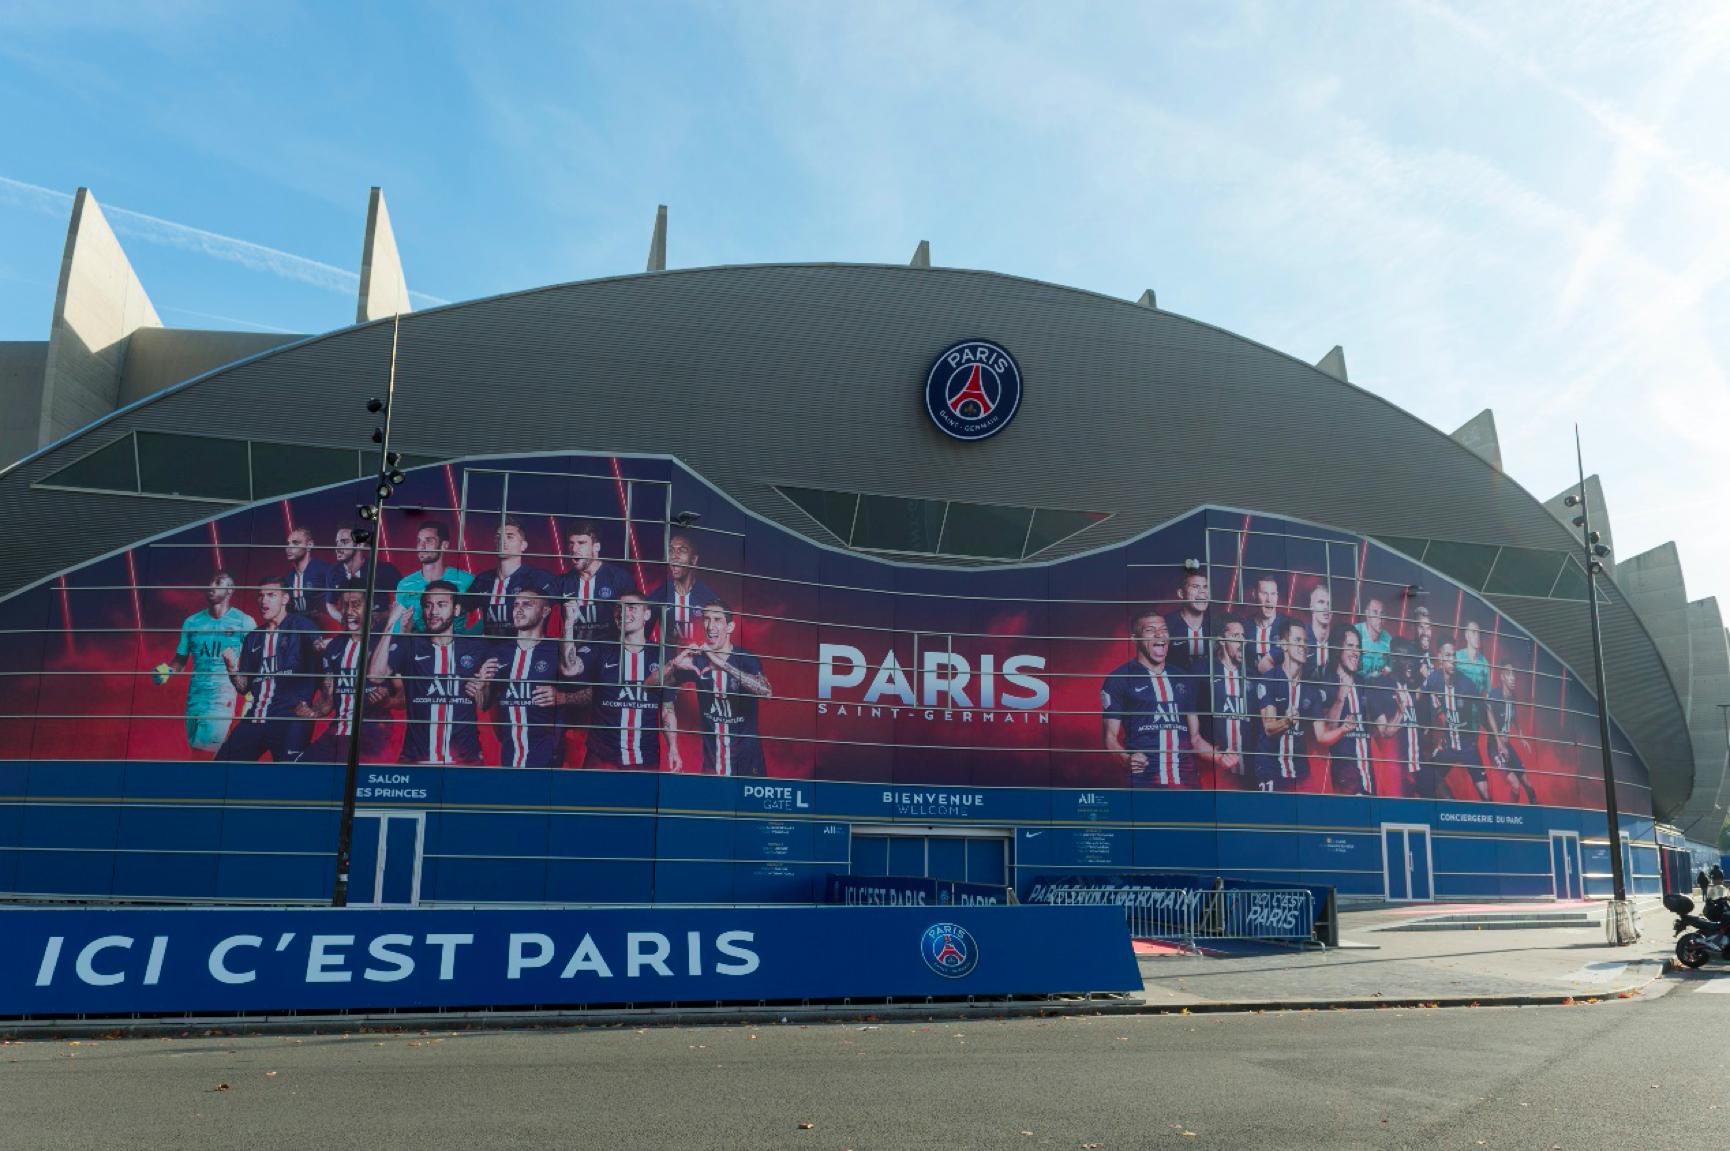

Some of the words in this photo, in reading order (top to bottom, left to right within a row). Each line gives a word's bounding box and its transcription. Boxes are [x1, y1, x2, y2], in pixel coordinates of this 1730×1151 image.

[948, 347, 1008, 374] PARIS
[818, 643, 1050, 710] PARIS
[818, 703, 1049, 724] SAINT-GERMAIN
[368, 774, 410, 784] SALON
[356, 787, 372, 798] ES
[374, 788, 428, 799] PRINCES
[744, 785, 793, 799] PORTE
[796, 790, 809, 808] L
[883, 791, 985, 806] BIENVENUE
[763, 799, 793, 811] GATE
[1440, 813, 1494, 824] CONCIERGERIE
[1246, 906, 1299, 929] PARIS
[928, 925, 966, 938] PARIS
[35, 936, 169, 987] ICI
[208, 932, 474, 985] C'EST
[506, 930, 761, 980] PARIS
